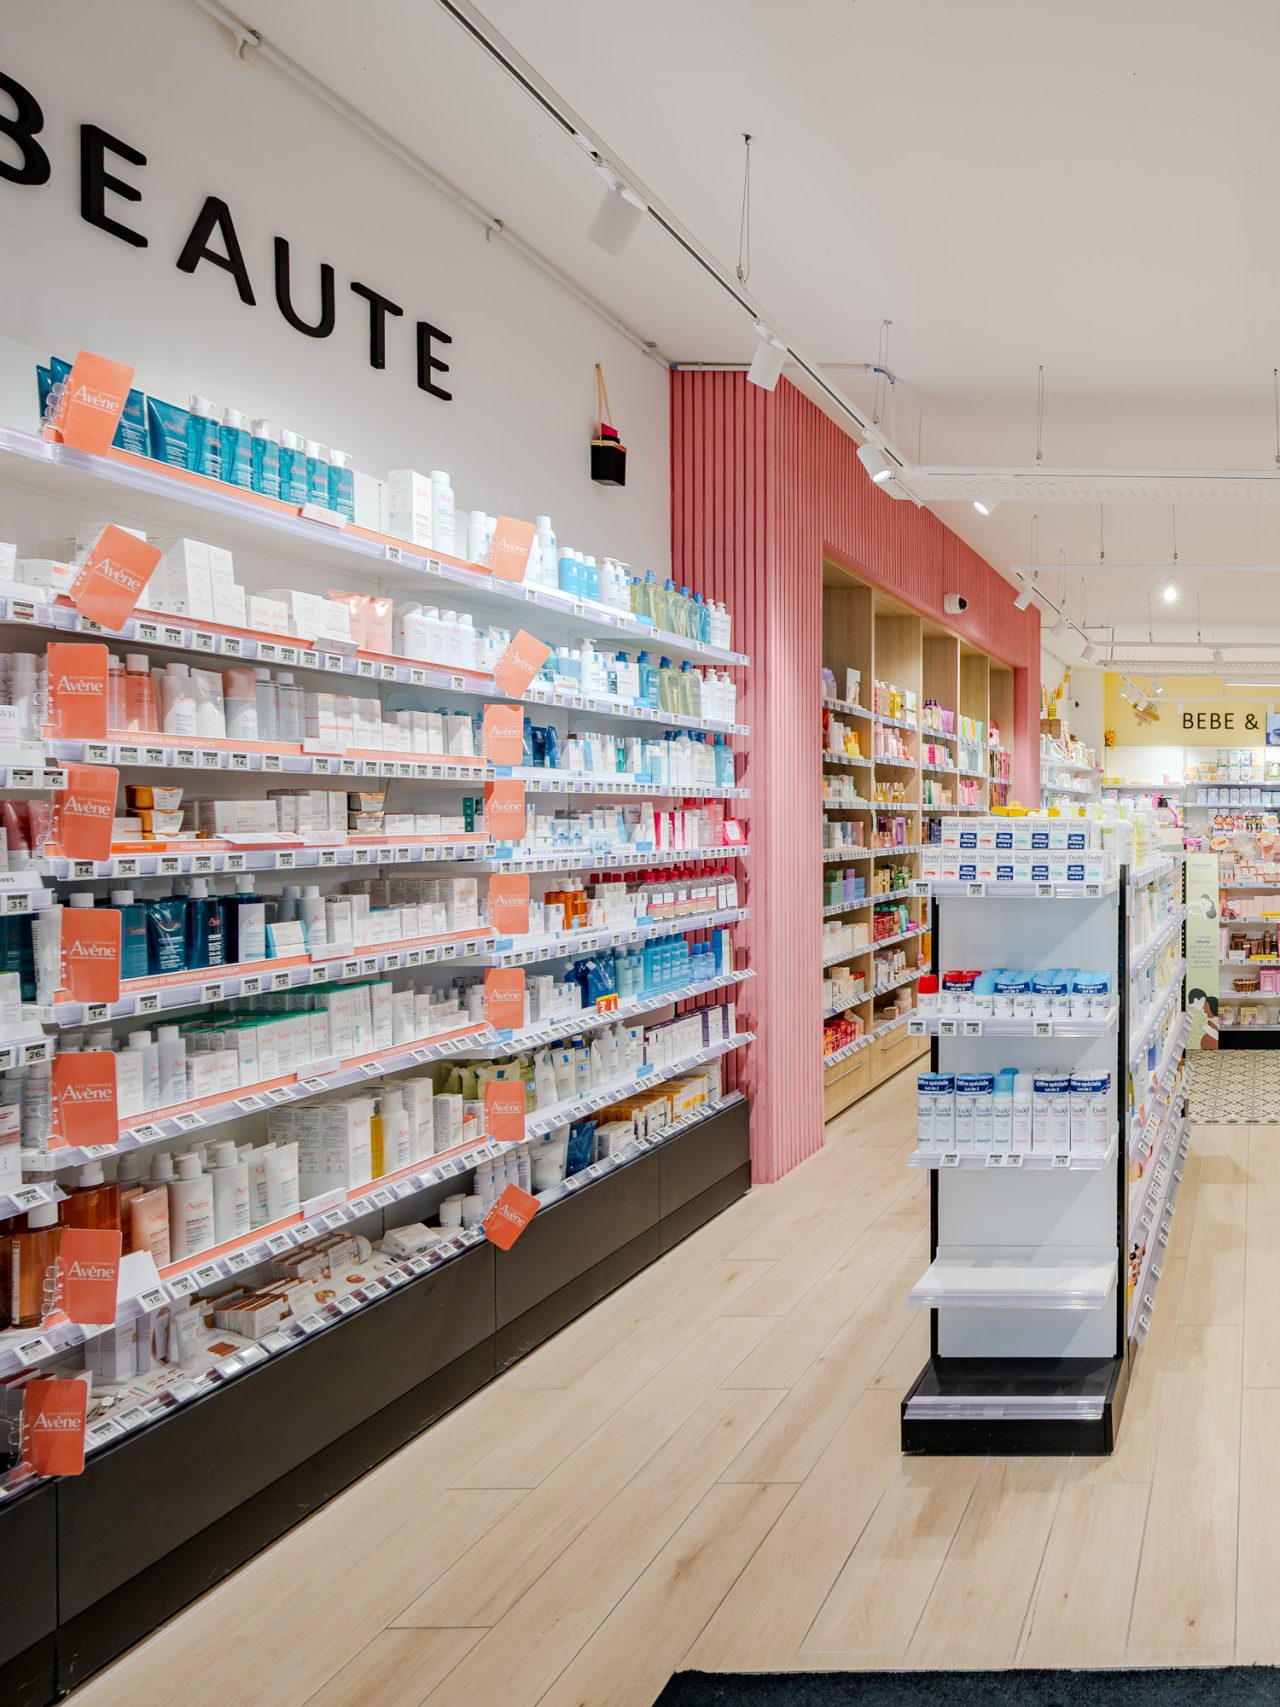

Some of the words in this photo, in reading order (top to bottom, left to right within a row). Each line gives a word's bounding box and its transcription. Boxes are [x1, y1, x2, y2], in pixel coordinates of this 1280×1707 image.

[0, 71, 453, 402] BEAUTE
[72, 385, 120, 411] Avène
[93, 558, 141, 590] Avène
[57, 675, 104, 692] Avène
[1182, 712, 1235, 730] BEBE
[1244, 712, 1260, 730] &
[489, 725, 521, 736] Avène
[63, 796, 111, 816] Avène
[490, 801, 521, 811] Avène
[495, 895, 527, 905] Avène
[69, 940, 116, 957] Avène
[490, 989, 522, 999] Avène
[62, 1085, 113, 1101] Avène
[491, 1102, 522, 1113] Avène
[499, 1204, 525, 1226] Avène
[67, 1261, 115, 1278] Avène
[33, 1412, 82, 1429] Avène
